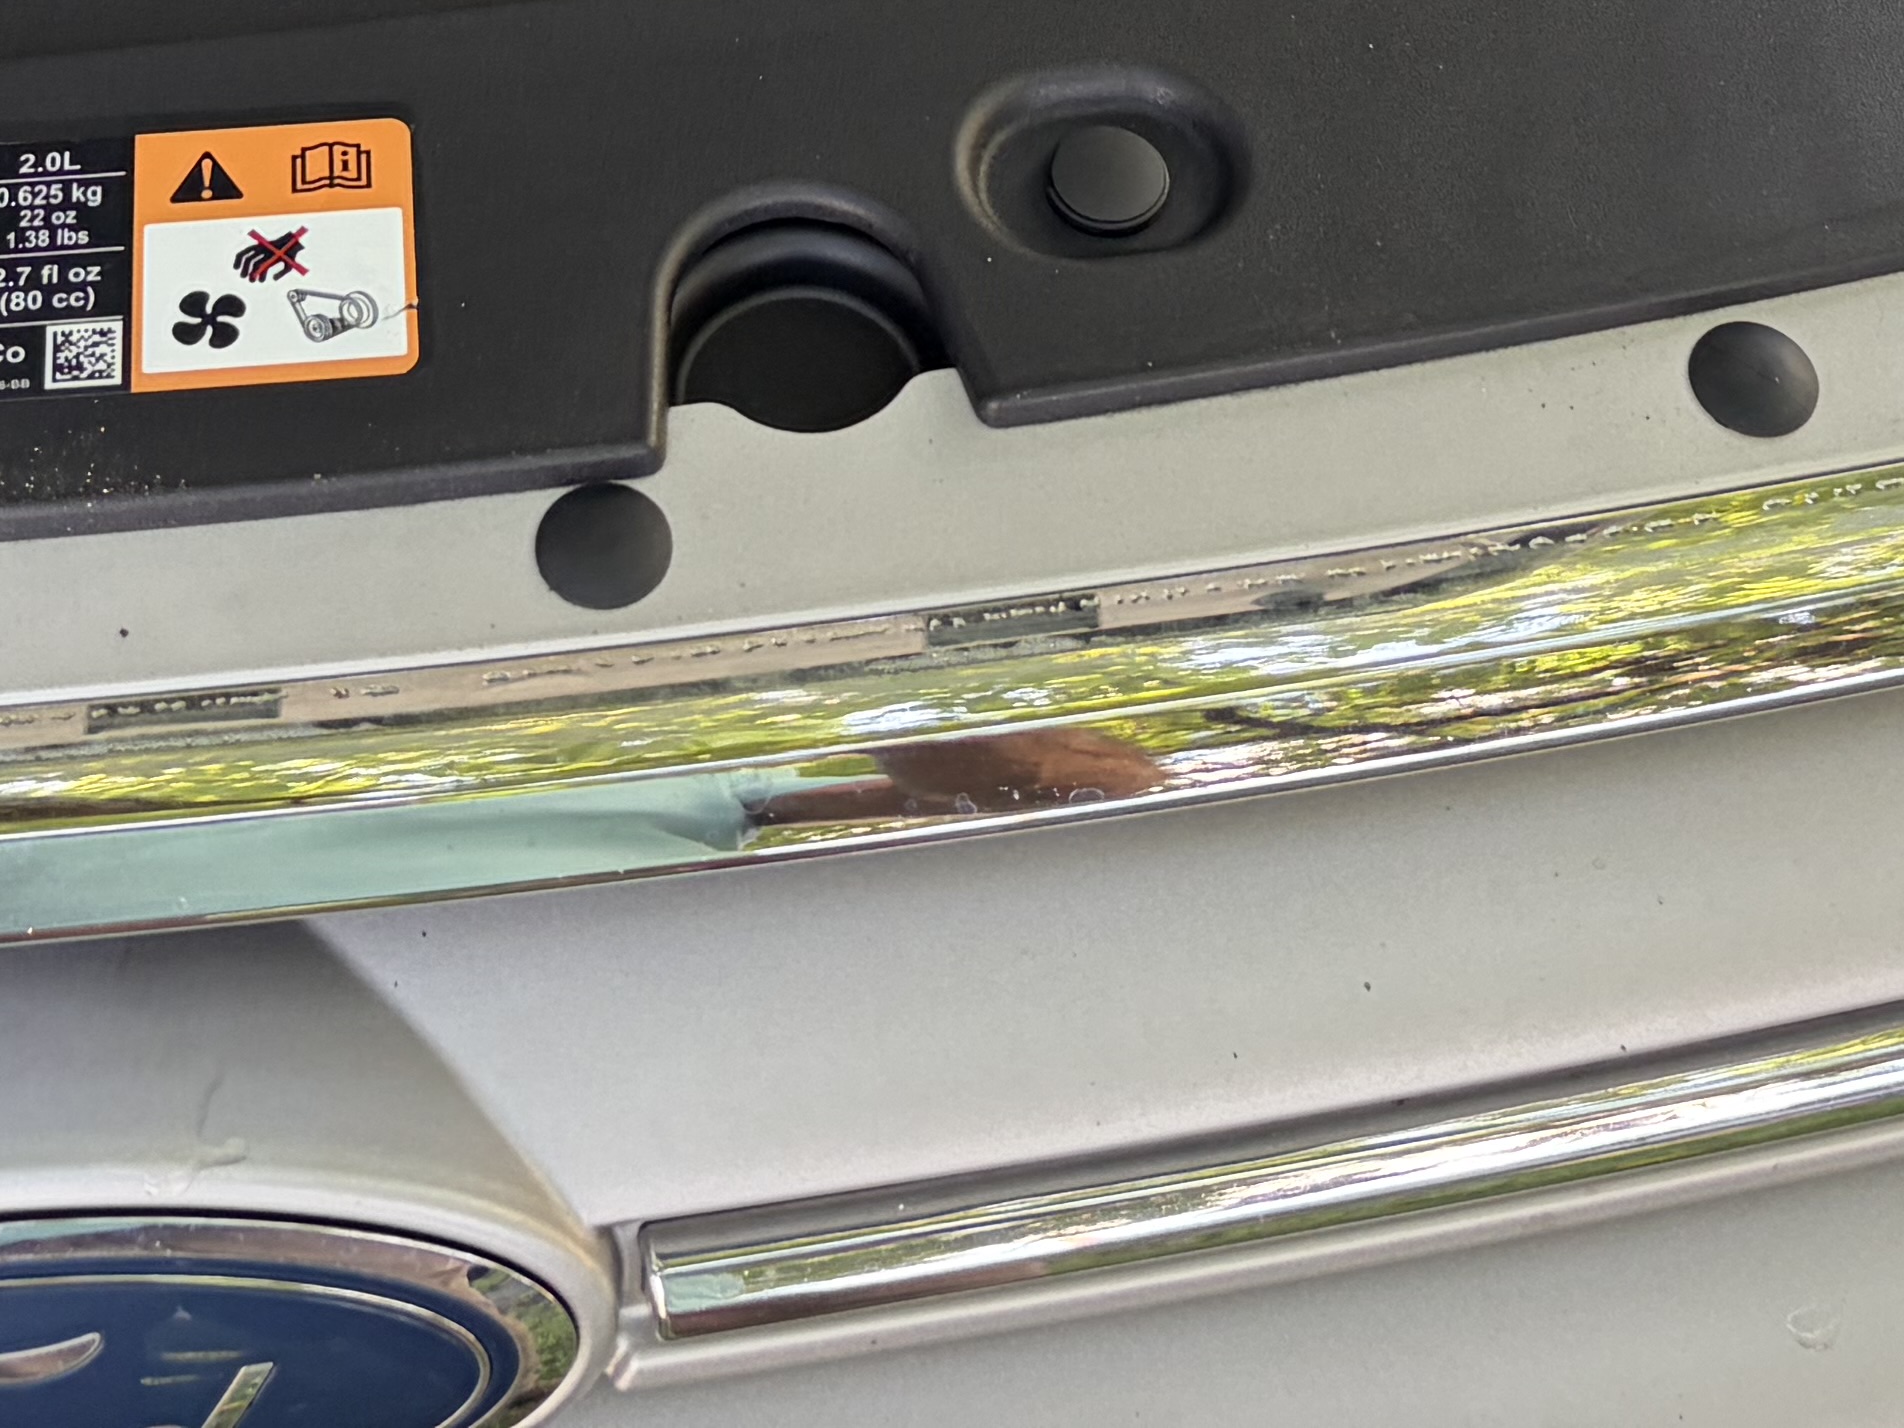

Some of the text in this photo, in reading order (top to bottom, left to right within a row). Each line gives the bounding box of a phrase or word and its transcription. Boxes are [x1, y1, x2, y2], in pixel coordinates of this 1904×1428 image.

[19, 150, 82, 174] 2.0L
[72, 182, 103, 207] kg
[19, 208, 77, 228] 22 oz
[6, 228, 90, 249] 1.38 lbs
[40, 264, 59, 285] fl
[68, 266, 102, 282] oz
[0, 286, 95, 317] (80 cc)
